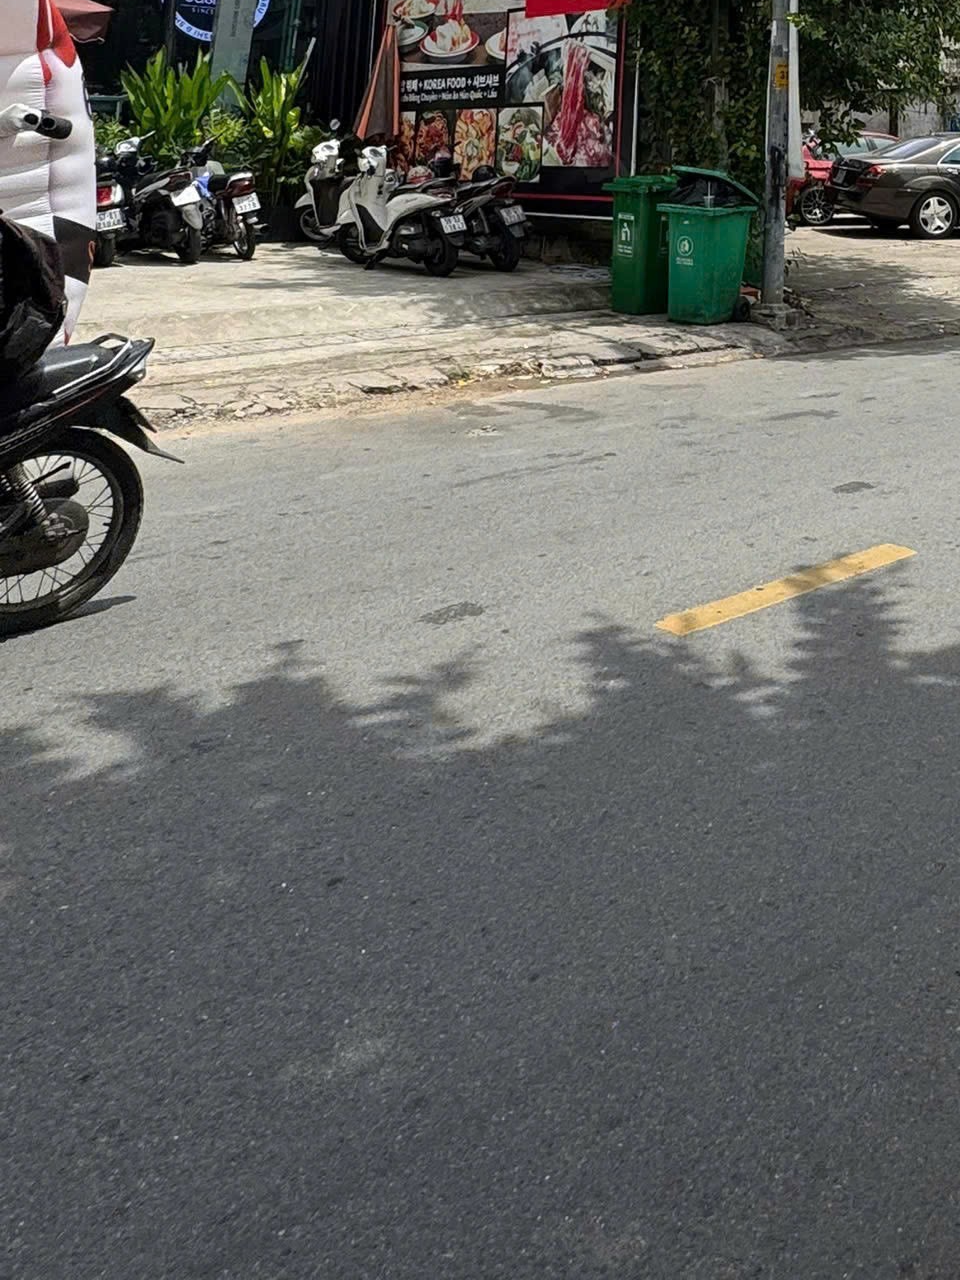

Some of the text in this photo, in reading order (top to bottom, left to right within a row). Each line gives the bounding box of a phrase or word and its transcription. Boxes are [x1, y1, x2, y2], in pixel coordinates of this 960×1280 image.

[423, 77, 446, 90] KOREA
[446, 76, 466, 89] FOOD
[472, 73, 500, 88] 샤브샤브
